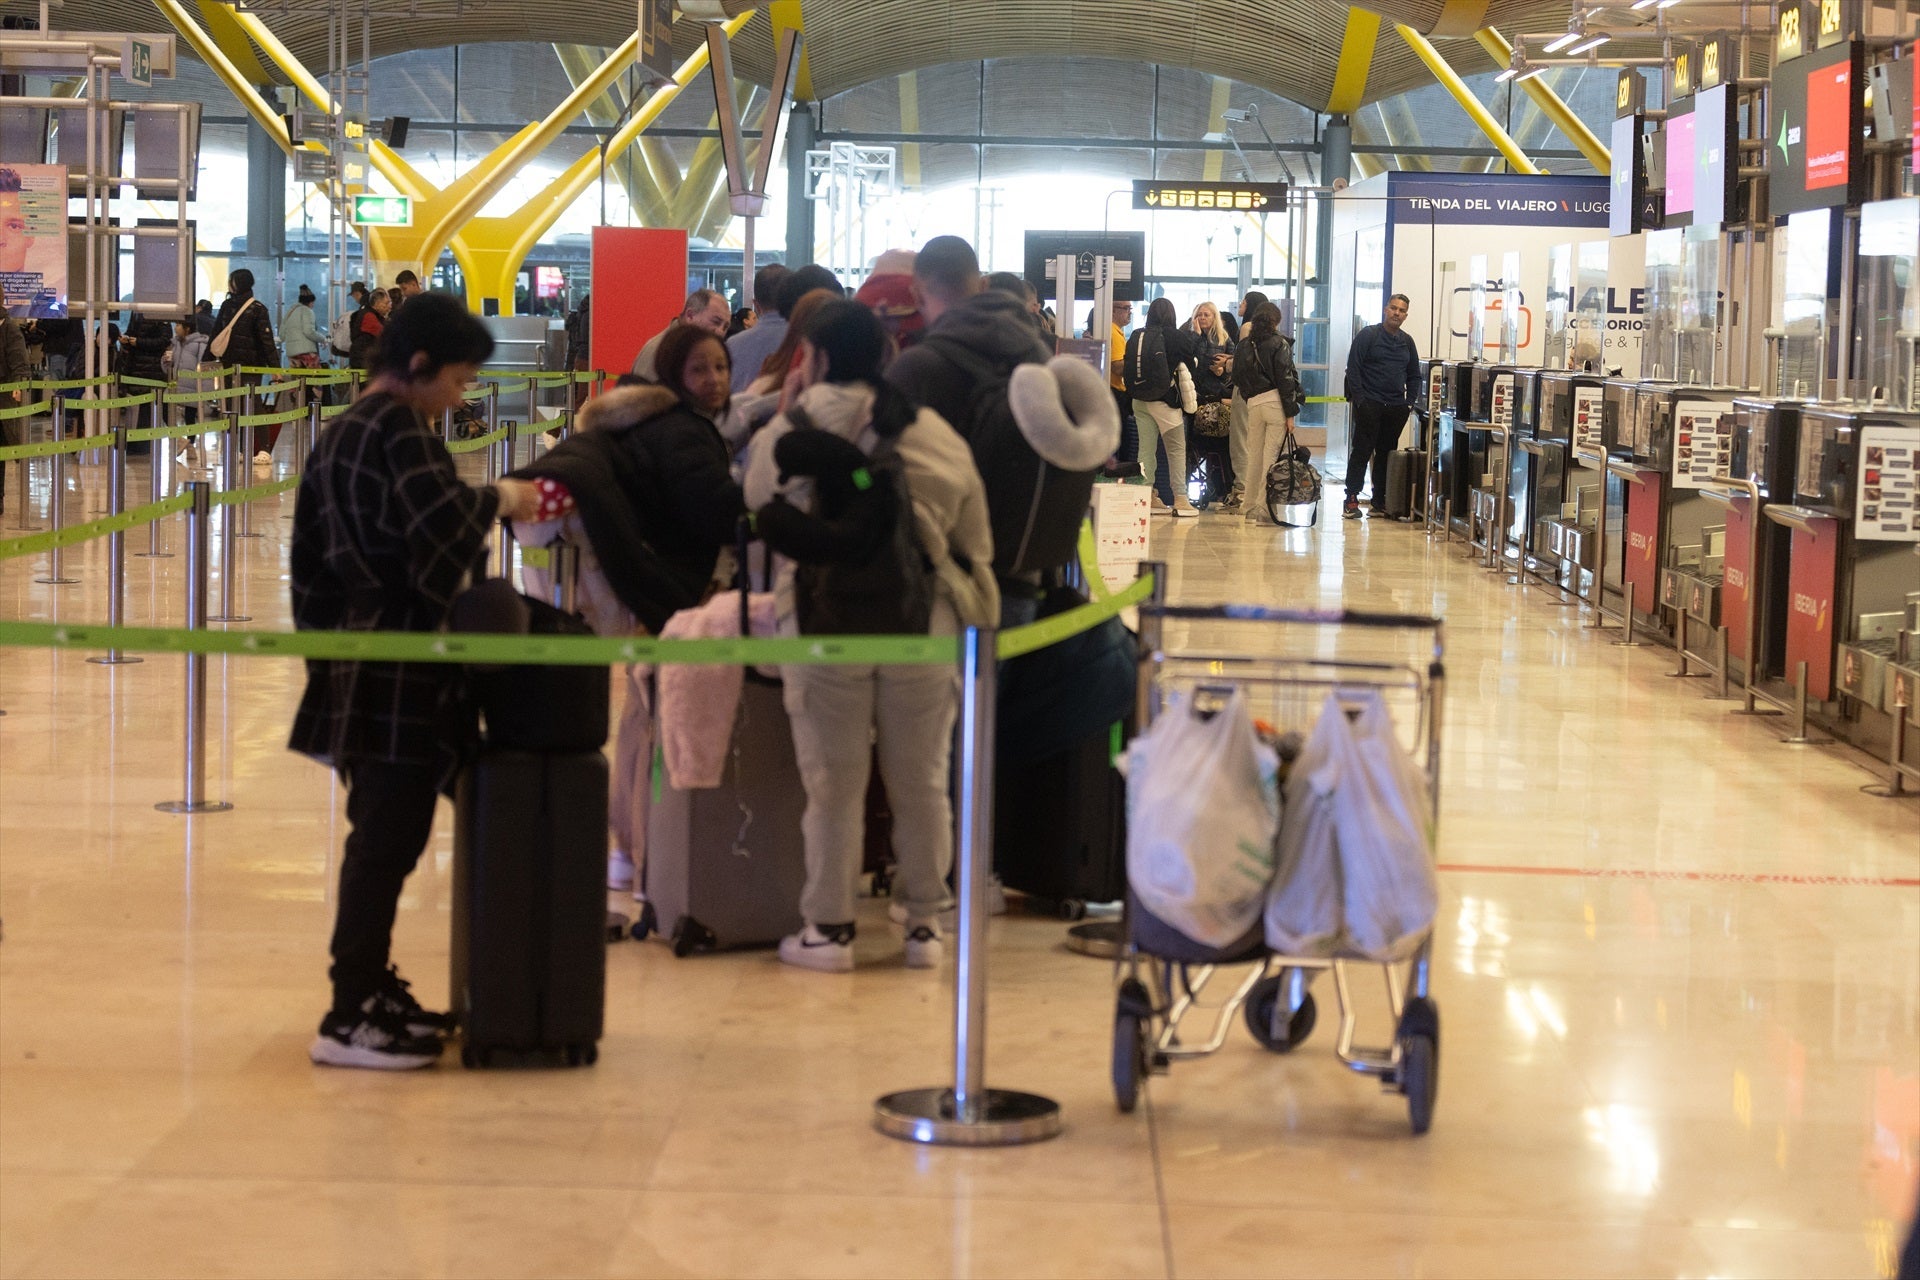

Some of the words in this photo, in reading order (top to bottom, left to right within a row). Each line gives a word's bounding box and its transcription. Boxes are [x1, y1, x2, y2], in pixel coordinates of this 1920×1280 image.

[1781, 7, 1799, 50] 823
[1821, 0, 1840, 35] 824
[1675, 53, 1688, 88] 821
[1704, 41, 1718, 78] 822
[1617, 76, 1630, 109] 820
[1409, 198, 1461, 210] TIENDA
[1464, 199, 1491, 210] DEL
[1497, 199, 1557, 212] VIAJERO
[1574, 201, 1611, 213] LUGG
[1617, 335, 1628, 348] &
[1630, 531, 1646, 551] IBERIA
[1726, 566, 1744, 589] IBERIA
[1794, 593, 1818, 618] IBERIA
